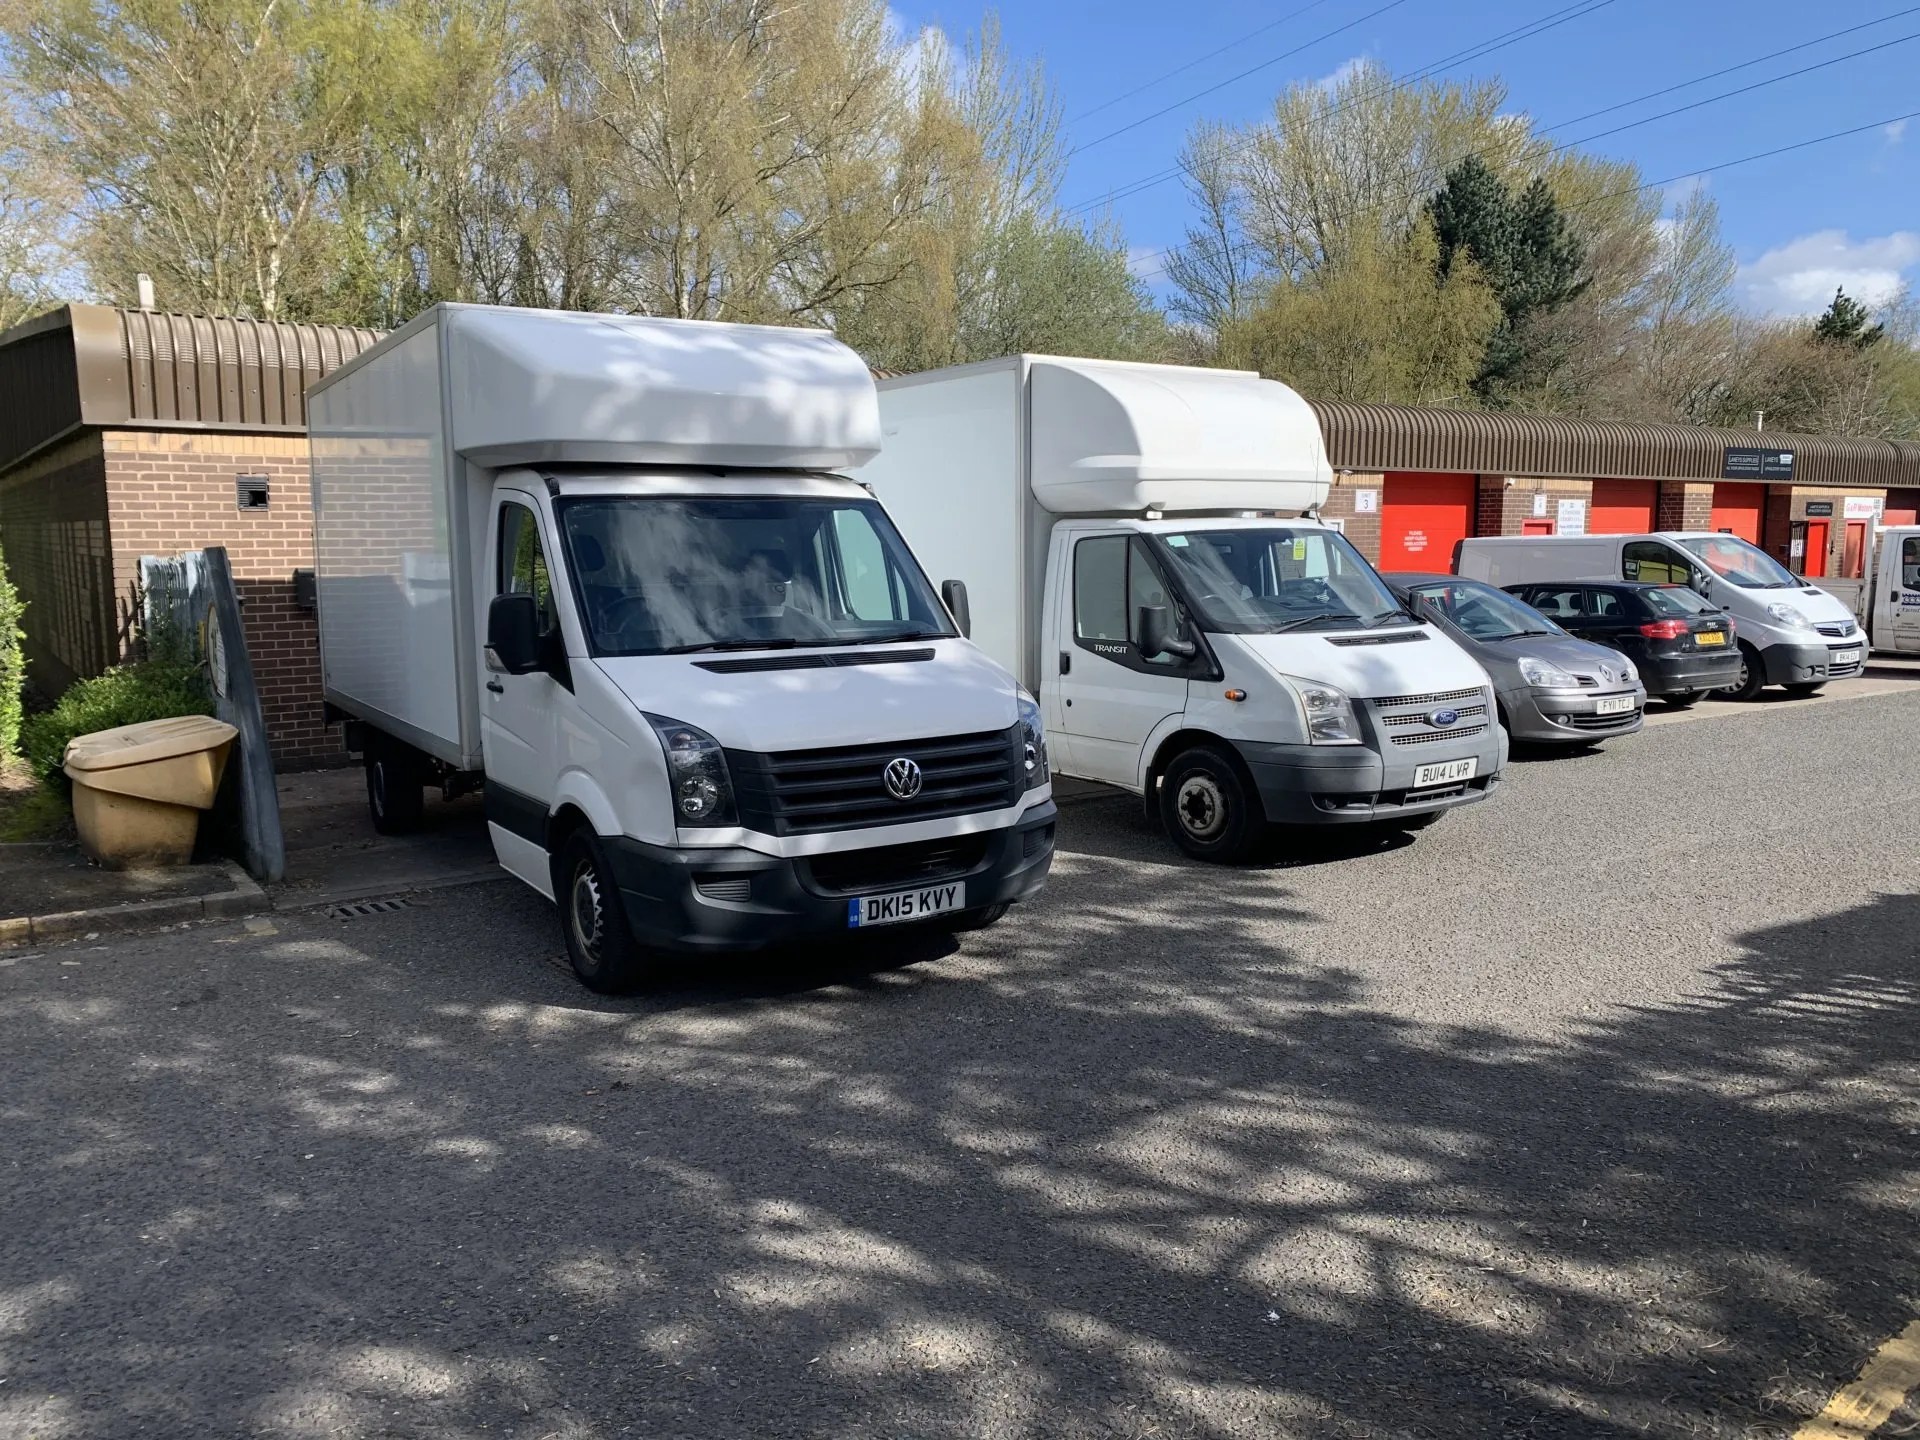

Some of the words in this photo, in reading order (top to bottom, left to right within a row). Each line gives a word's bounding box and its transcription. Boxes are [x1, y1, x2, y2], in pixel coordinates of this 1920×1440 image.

[1363, 499, 1368, 509] 3
[1094, 644, 1127, 654] TRANSIT
[1603, 700, 1616, 710] FY11
[1618, 699, 1629, 709] TCJ
[1422, 765, 1446, 782] BU14
[867, 894, 913, 921] DK15
[920, 886, 956, 912] KVY
